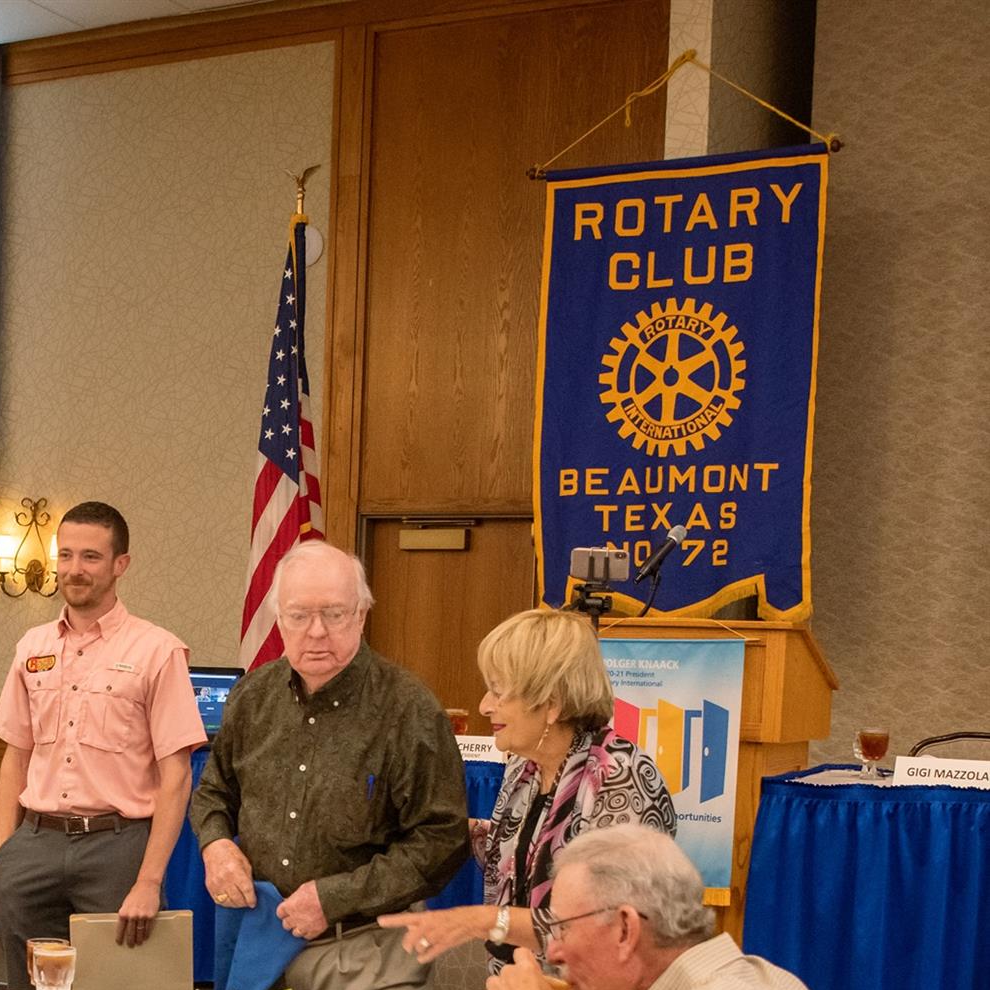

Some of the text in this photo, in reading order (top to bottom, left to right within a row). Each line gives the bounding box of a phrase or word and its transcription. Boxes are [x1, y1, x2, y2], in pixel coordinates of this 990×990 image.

[573, 182, 803, 241] ROTARY
[608, 242, 754, 291] CLUB
[643, 314, 713, 341] ROTARY
[623, 397, 724, 441] INTERNATIONAL
[558, 462, 779, 497] BEAUMONT
[594, 501, 737, 532] TEXAS
[681, 538, 729, 567] 72
[637, 659, 680, 670] KNAACK
[907, 767, 989, 781] GIGI MAZZOLA
